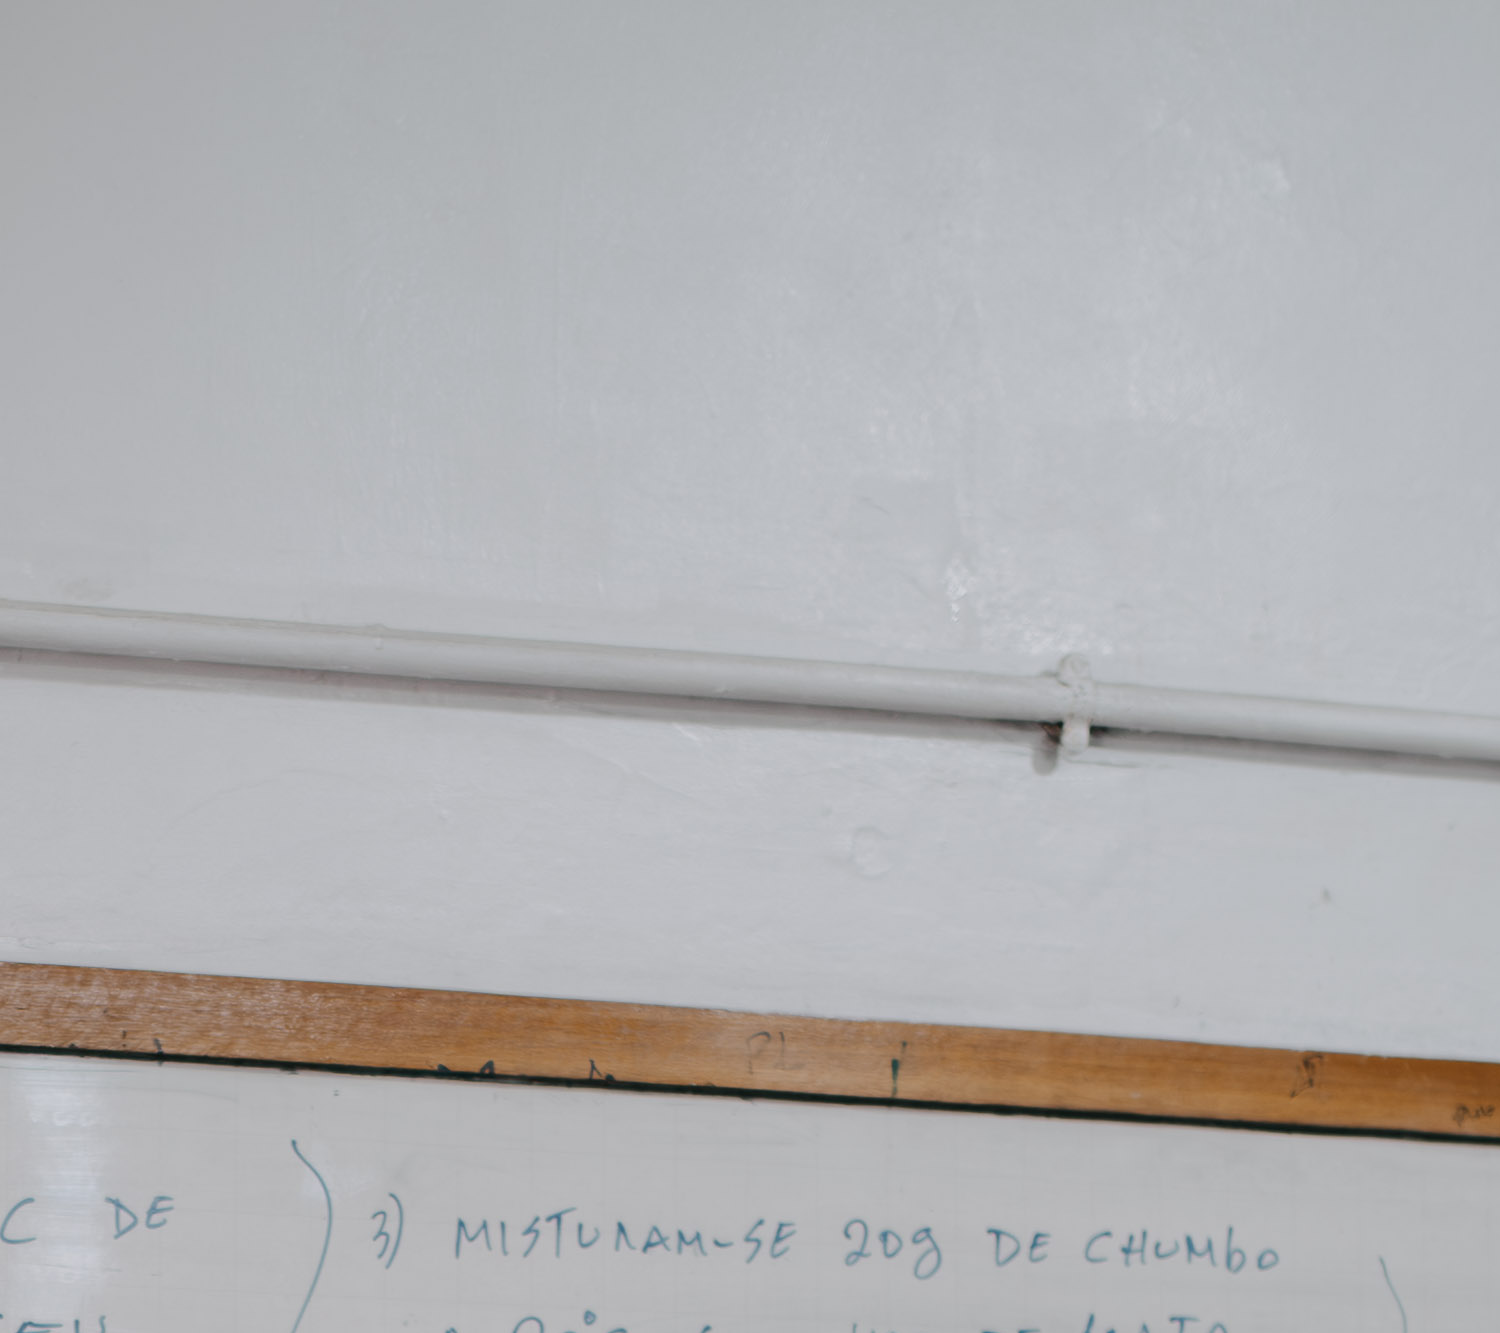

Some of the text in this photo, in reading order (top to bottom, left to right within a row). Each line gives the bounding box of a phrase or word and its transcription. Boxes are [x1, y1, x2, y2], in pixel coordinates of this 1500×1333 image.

[106, 1194, 176, 1239] DE
[842, 1219, 943, 1280] 20g
[987, 1227, 1052, 1268] DE
